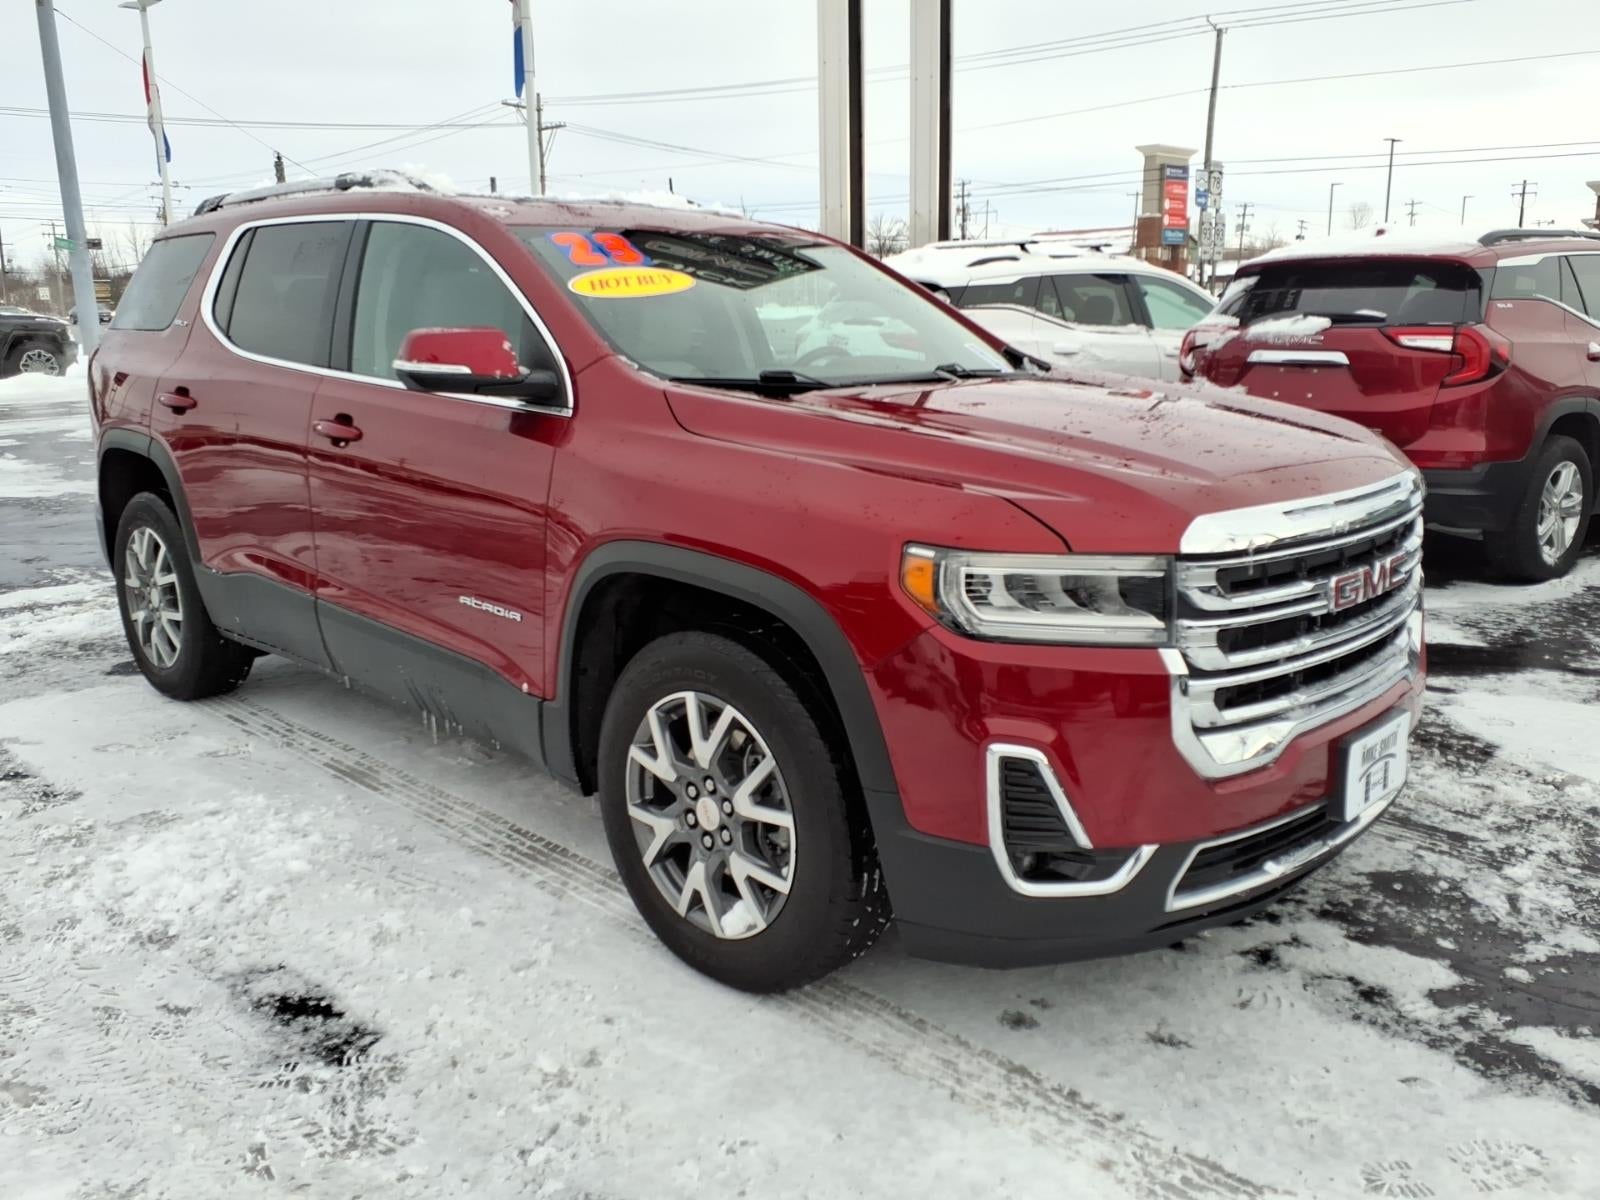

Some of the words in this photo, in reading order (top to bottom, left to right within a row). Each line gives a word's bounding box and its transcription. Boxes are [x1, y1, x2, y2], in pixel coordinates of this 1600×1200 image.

[550, 232, 644, 266] 23
[589, 276, 634, 292] HOT
[636, 273, 674, 286] BUY
[1329, 551, 1408, 614] GMC
[459, 595, 521, 622] ACADIA
